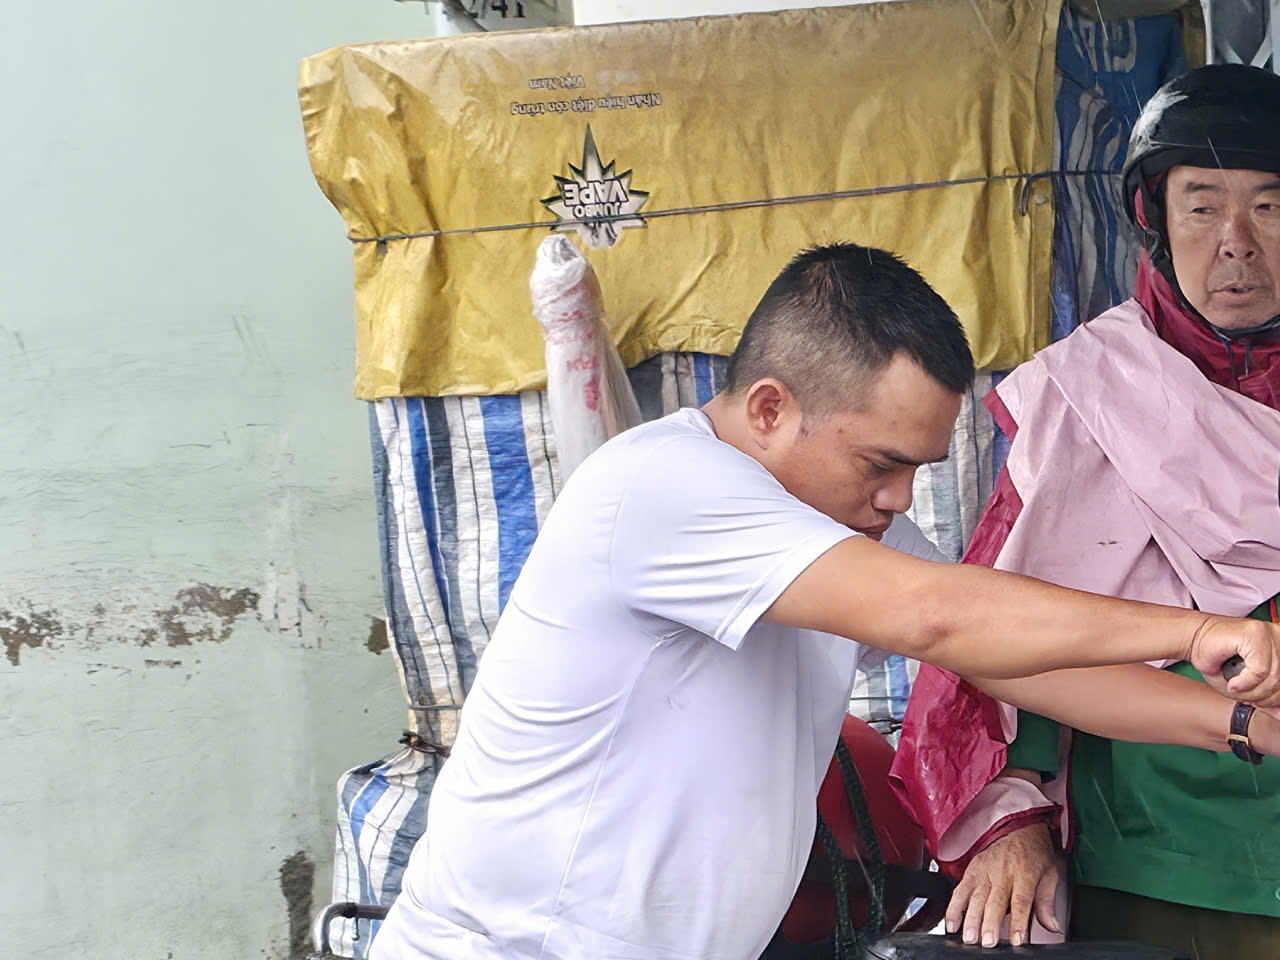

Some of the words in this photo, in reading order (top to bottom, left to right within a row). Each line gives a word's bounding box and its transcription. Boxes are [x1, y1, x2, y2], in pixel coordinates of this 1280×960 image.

[529, 77, 560, 90] Nam
[560, 73, 585, 89] Việt
[510, 101, 546, 116] trùng
[571, 96, 597, 112] diệt
[561, 180, 629, 207] VAPE
[572, 202, 621, 219] JUMBO
